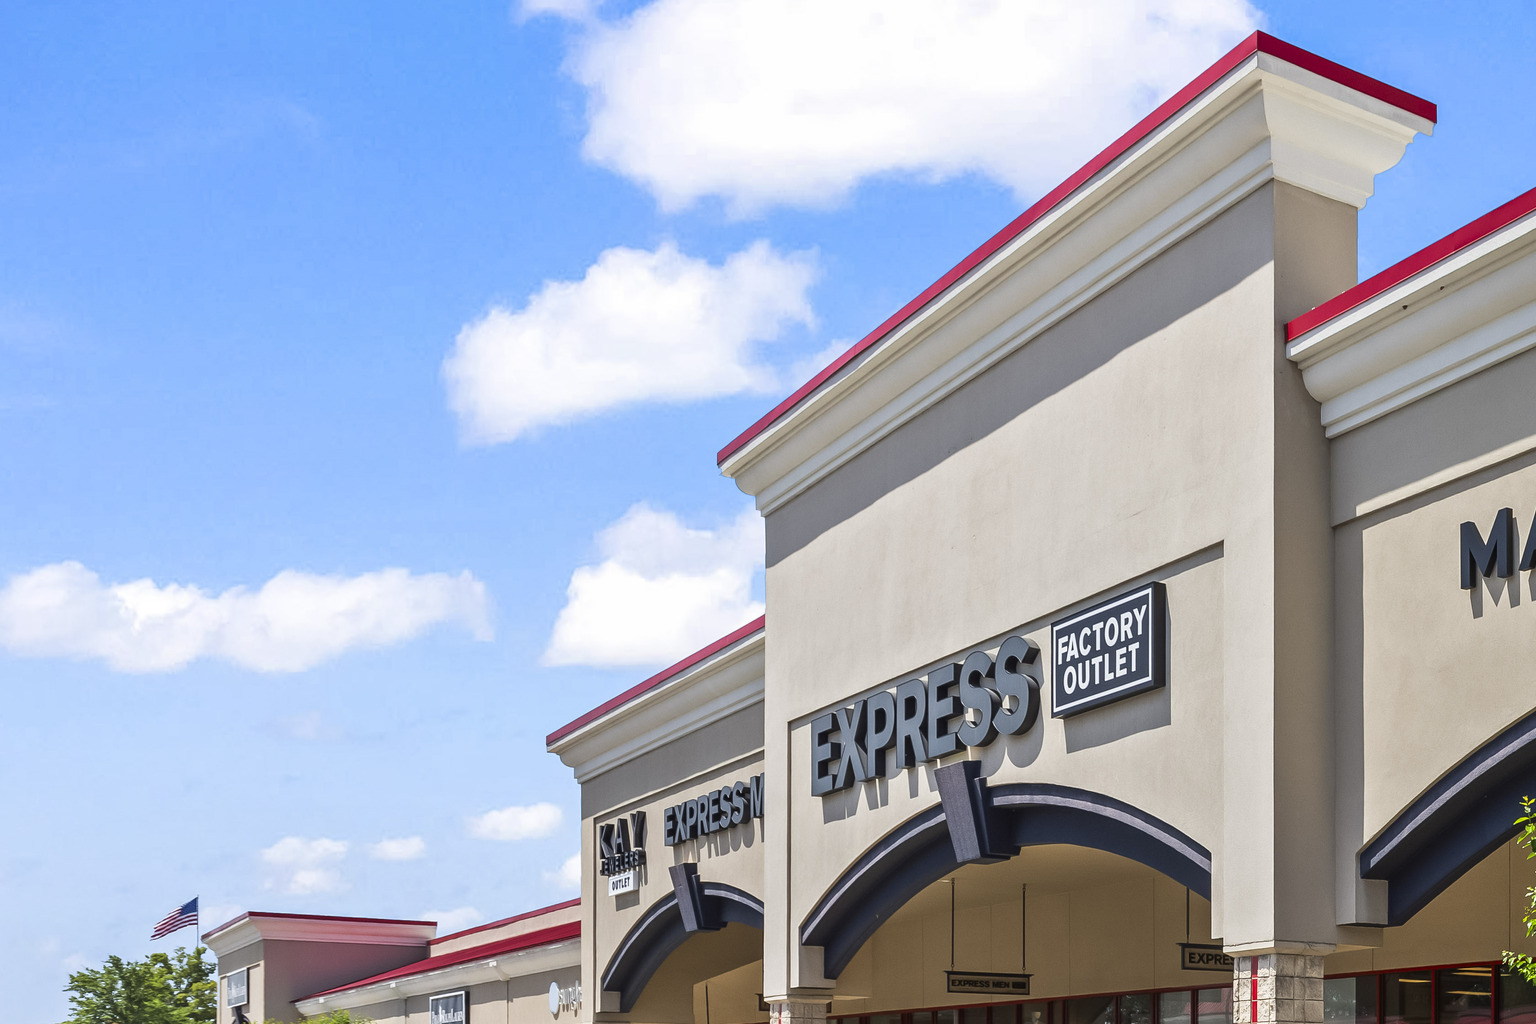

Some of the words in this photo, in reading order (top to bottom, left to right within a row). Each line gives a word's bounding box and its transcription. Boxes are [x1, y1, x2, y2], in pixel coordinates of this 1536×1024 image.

[1058, 604, 1147, 665] FACTORY
[1062, 641, 1140, 695] OUTLET
[811, 635, 1040, 796] EXPRESS
[600, 811, 646, 860] KAY
[664, 781, 750, 846] EXPRESS
[600, 848, 646, 876] JEWELERS
[612, 877, 630, 891] OUTLET
[951, 979, 990, 988] EXPRESS
[992, 981, 1010, 989] MEN
